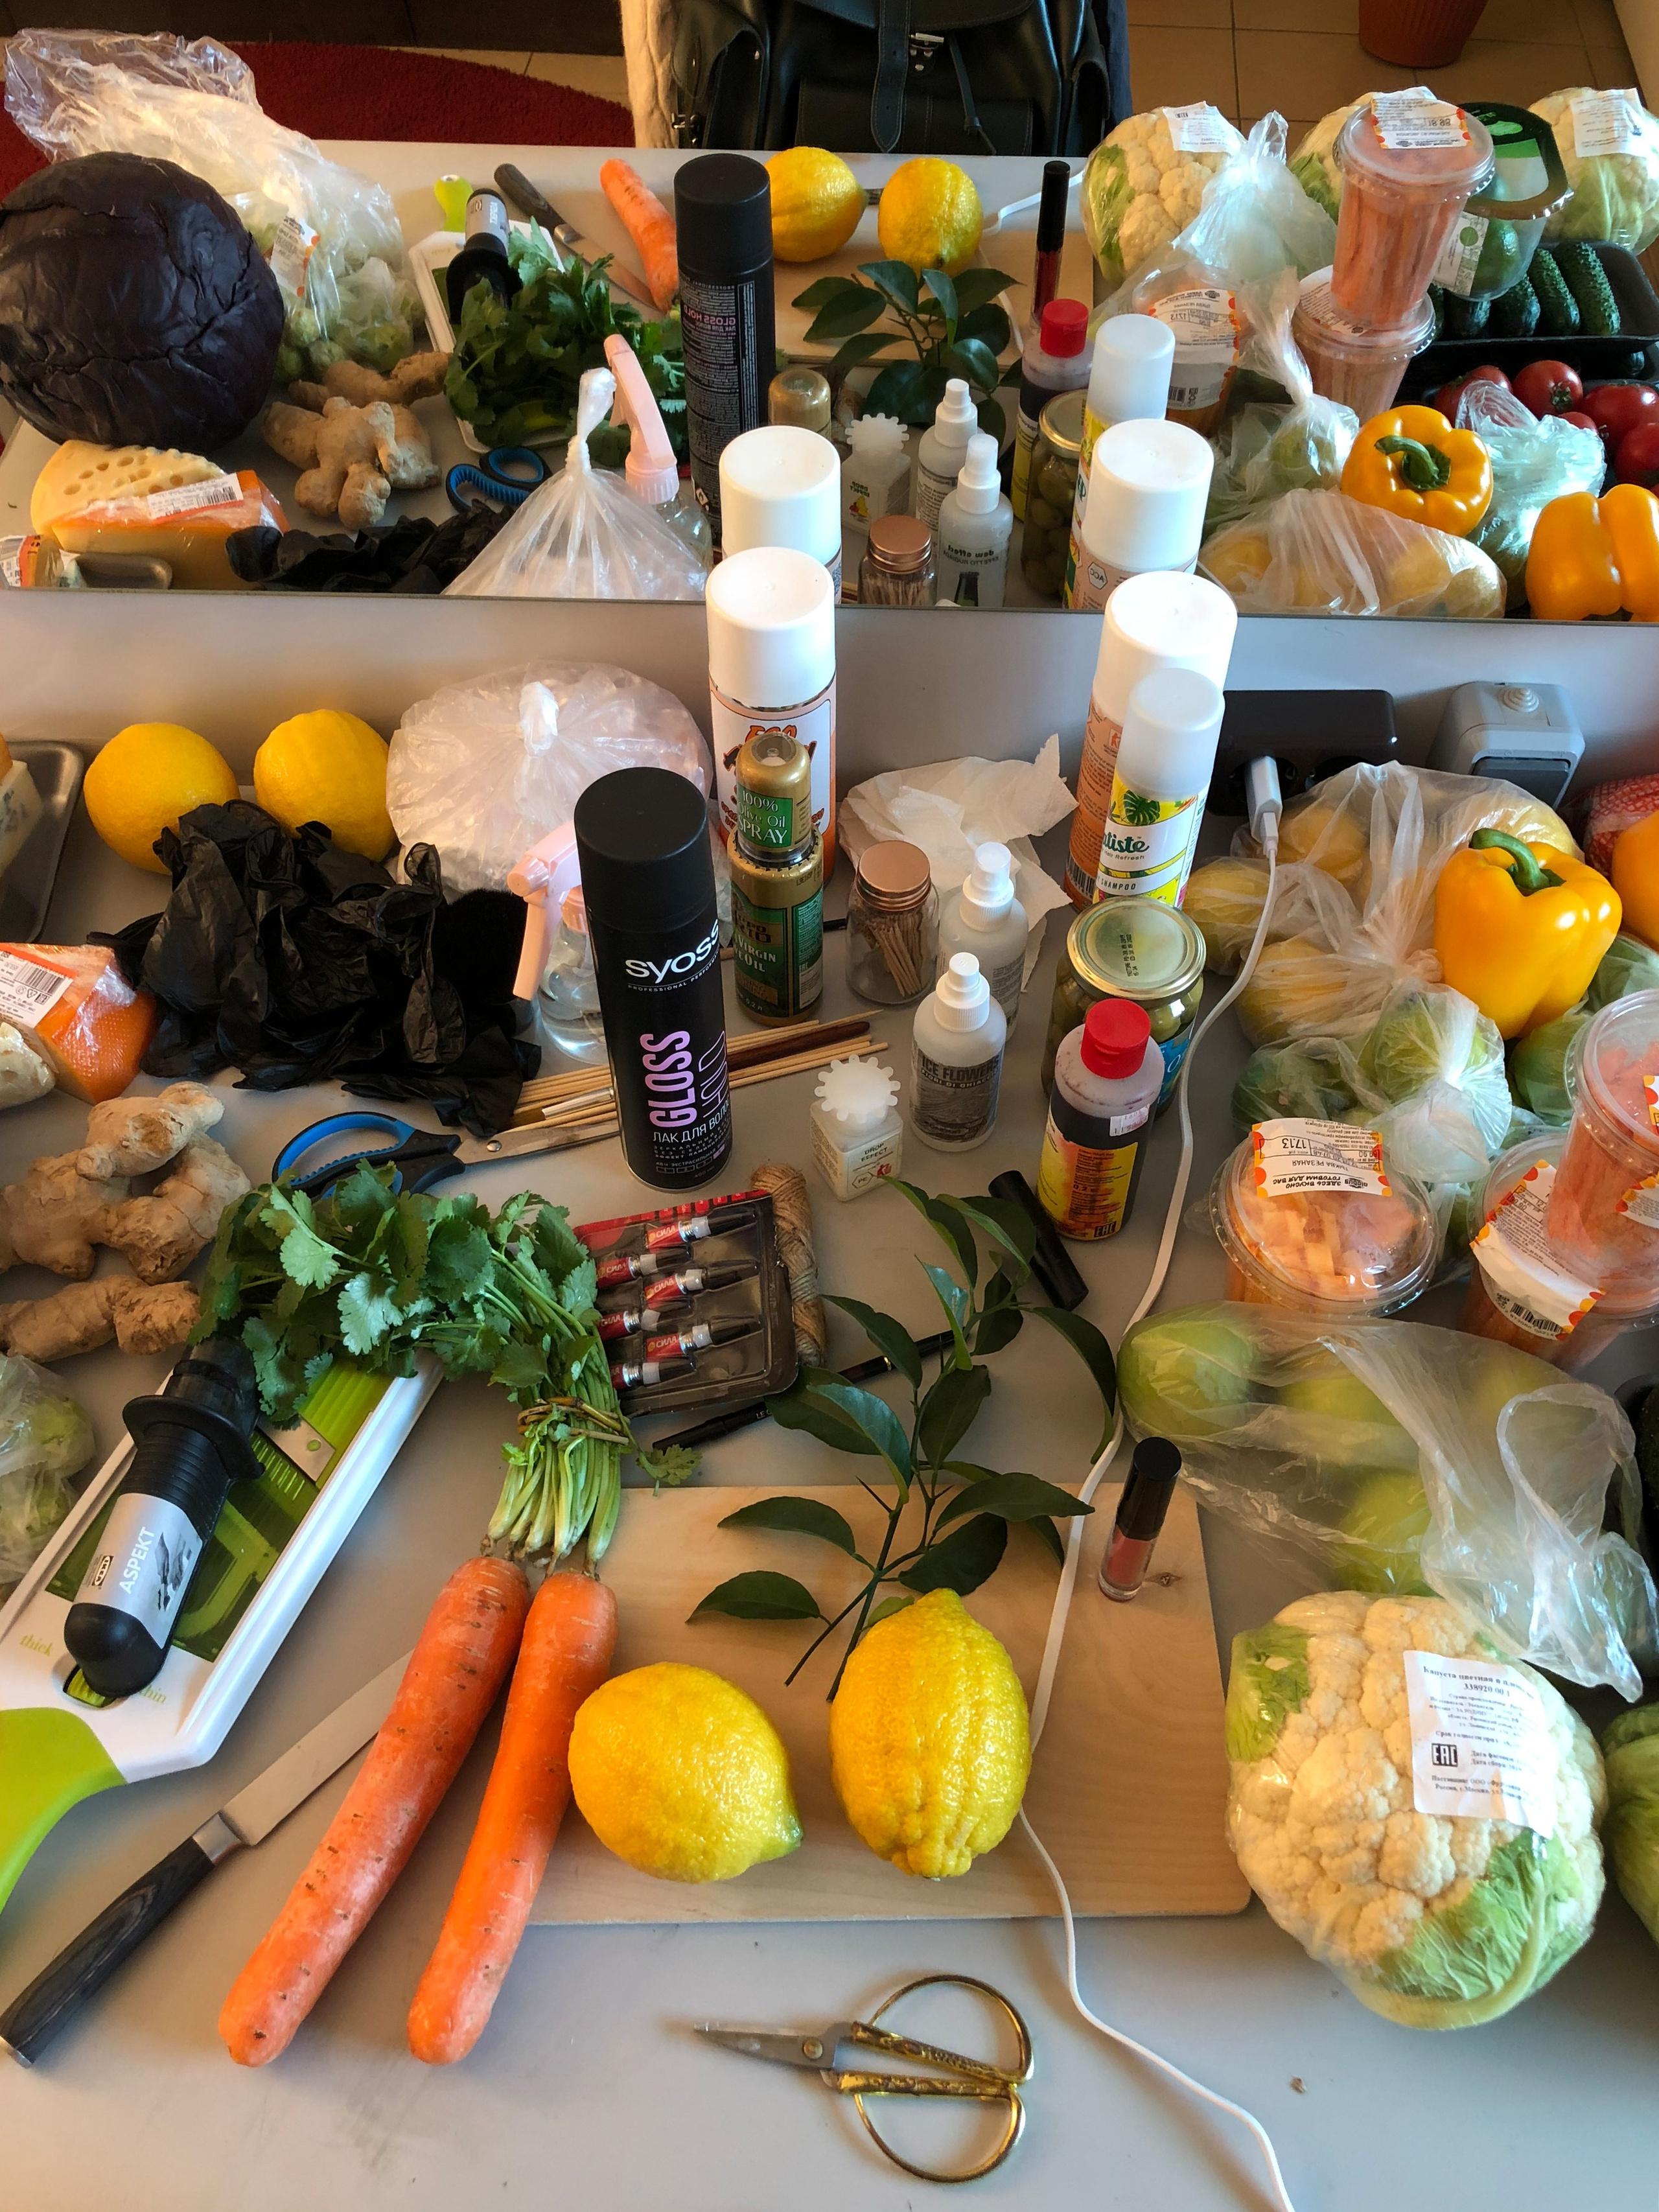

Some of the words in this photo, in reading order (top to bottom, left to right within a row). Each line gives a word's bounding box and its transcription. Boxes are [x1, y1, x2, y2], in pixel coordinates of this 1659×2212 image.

[743, 790, 778, 812] 100%
[738, 802, 762, 824] Olive
[767, 815, 785, 828] Oil
[739, 815, 787, 844] SPRAY
[1103, 831, 1150, 854] atiste
[1101, 878, 1137, 891] SHAMPOO
[739, 938, 776, 963] VIRGIN
[628, 983, 688, 992] PROFESSIONAL
[922, 1056, 939, 1076] ICE
[943, 1055, 999, 1081] FLOWERS
[640, 1030, 697, 1128] GLOSS
[653, 1132, 679, 1143] ЛАК
[681, 1123, 706, 1143] ДЛЯ
[1282, 1137, 1306, 1149] 17.13
[861, 1147, 888, 1162] EFFECT
[864, 1143, 884, 1155] DROP
[1326, 1163, 1349, 1171] ТЫКВА
[656, 1225, 676, 1238] СИЛА
[1094, 1221, 1117, 1238] EAC
[654, 1277, 675, 1292] СИЛА
[656, 1336, 677, 1348] СИЛА
[119, 1526, 155, 1594] ASPEKT
[95, 1557, 110, 1585] IKEA
[19, 1635, 52, 1657] thick
[1424, 1666, 1457, 1679] Капуста
[1432, 1743, 1458, 1767] EAC
